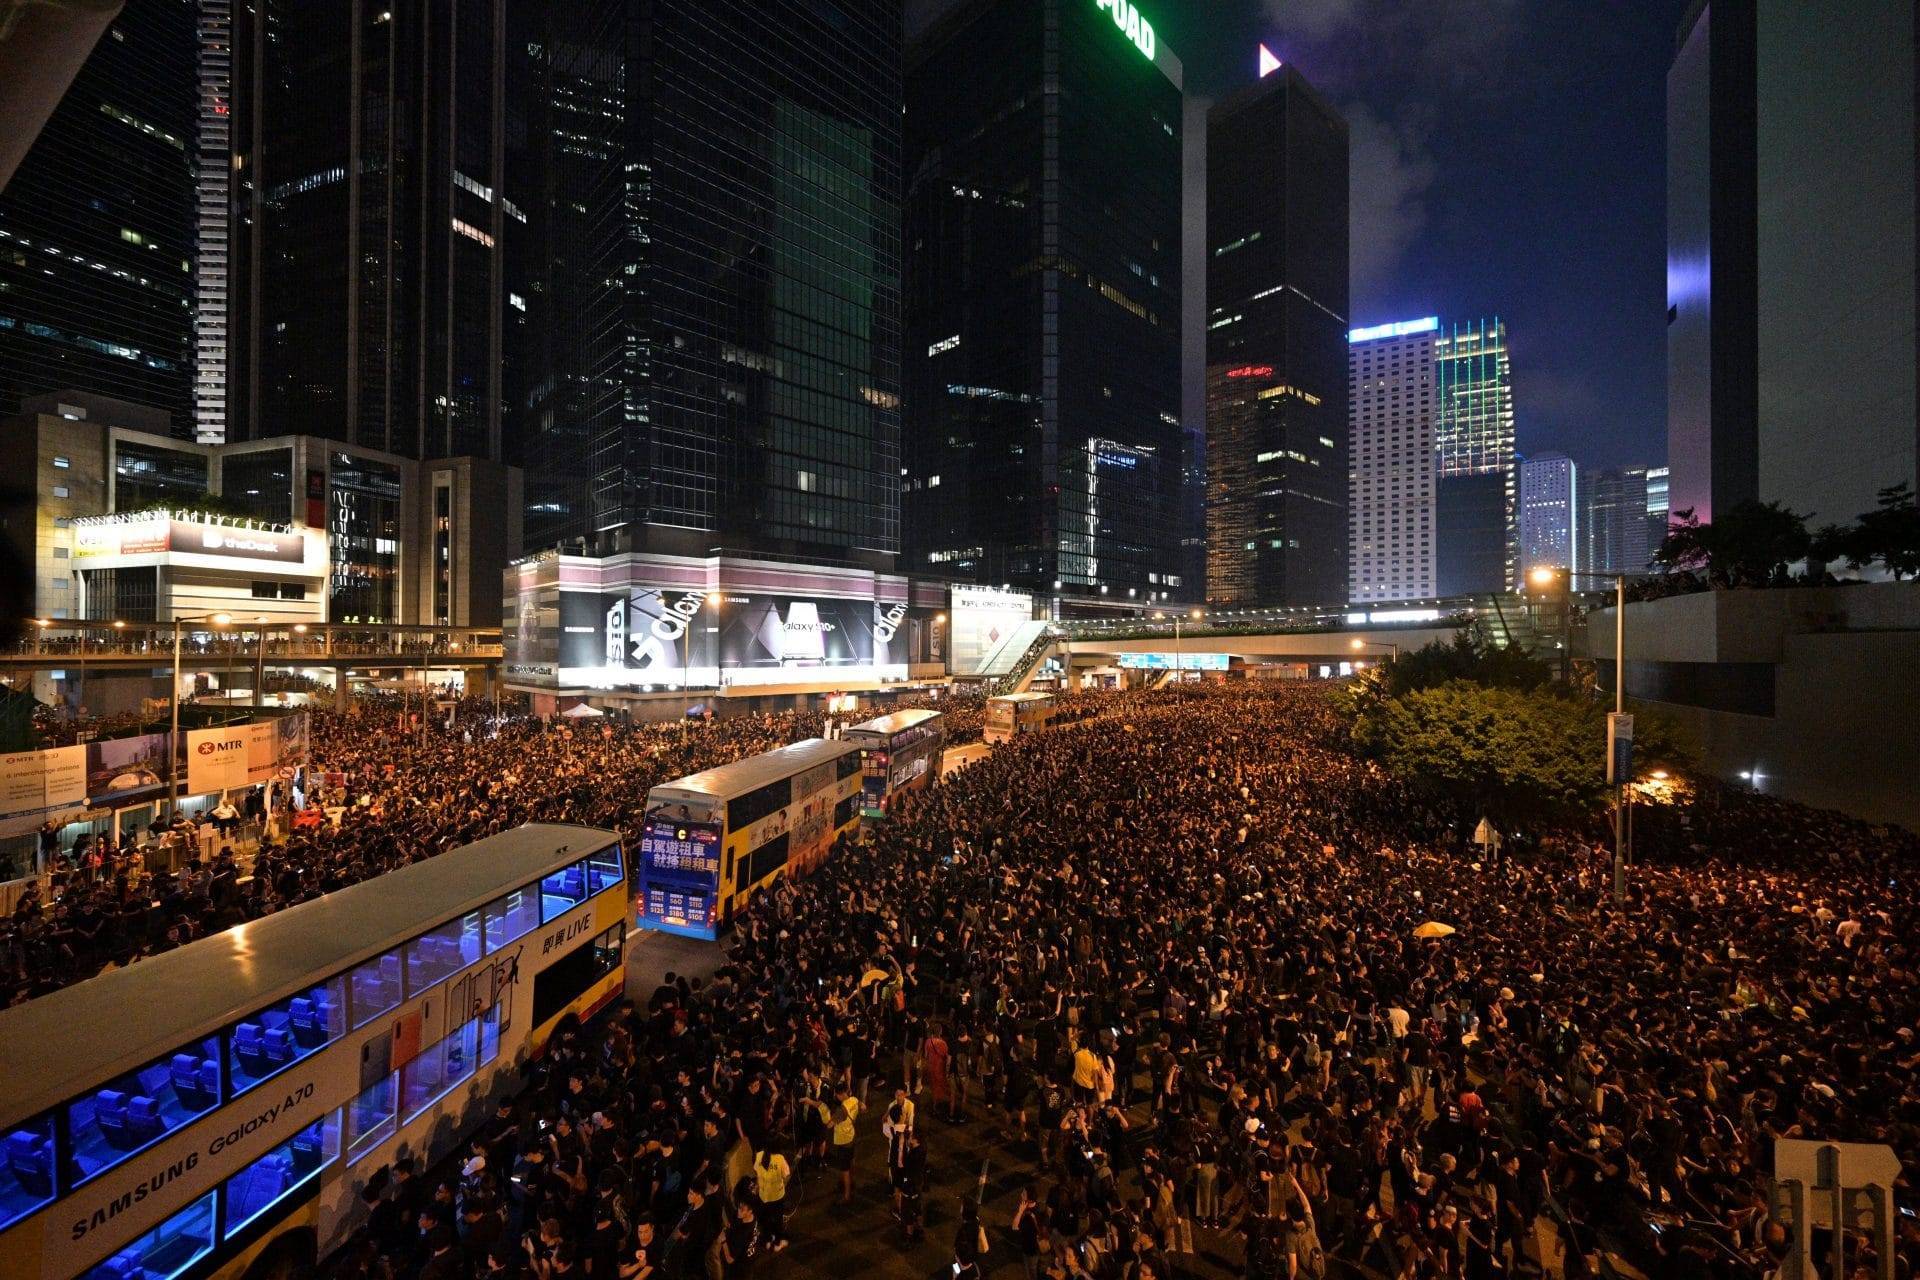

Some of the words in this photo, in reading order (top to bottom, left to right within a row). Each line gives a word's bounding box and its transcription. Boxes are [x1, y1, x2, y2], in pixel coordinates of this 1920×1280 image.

[217, 740, 242, 751] MTR
[57, 764, 80, 772] stations
[567, 912, 592, 941] LIVE
[72, 1152, 199, 1241] SAMSUNG
[208, 1106, 281, 1156] Galaxy
[282, 1083, 315, 1114] A70
